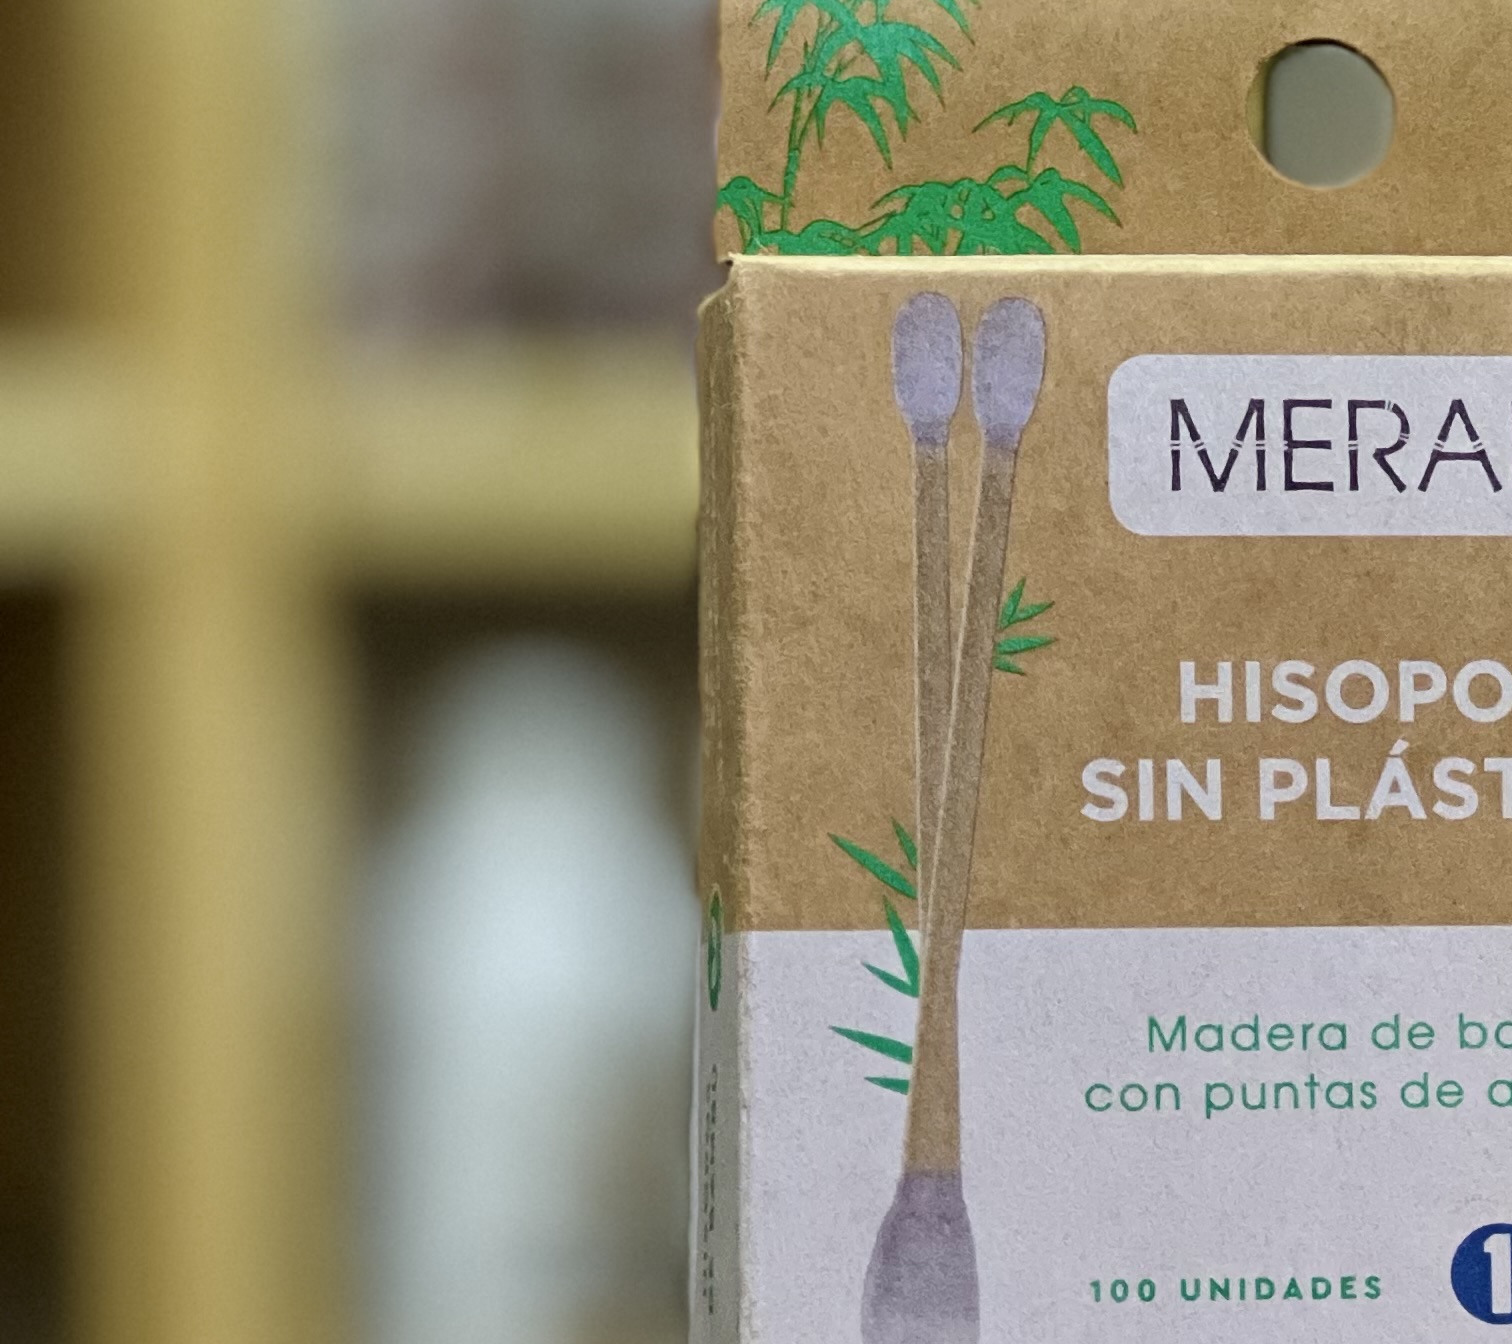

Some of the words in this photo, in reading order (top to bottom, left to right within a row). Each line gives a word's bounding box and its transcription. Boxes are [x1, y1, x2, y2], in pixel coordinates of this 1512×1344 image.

[1080, 757, 1222, 822] SIN
[1147, 1014, 1348, 1053] Madera
[1372, 1014, 1436, 1051] de
[1084, 1078, 1181, 1113] con
[1205, 1072, 1378, 1119] puntas
[1401, 1072, 1465, 1109] de
[1089, 1279, 1157, 1303] 100
[1180, 1275, 1382, 1302] UNIDADES
